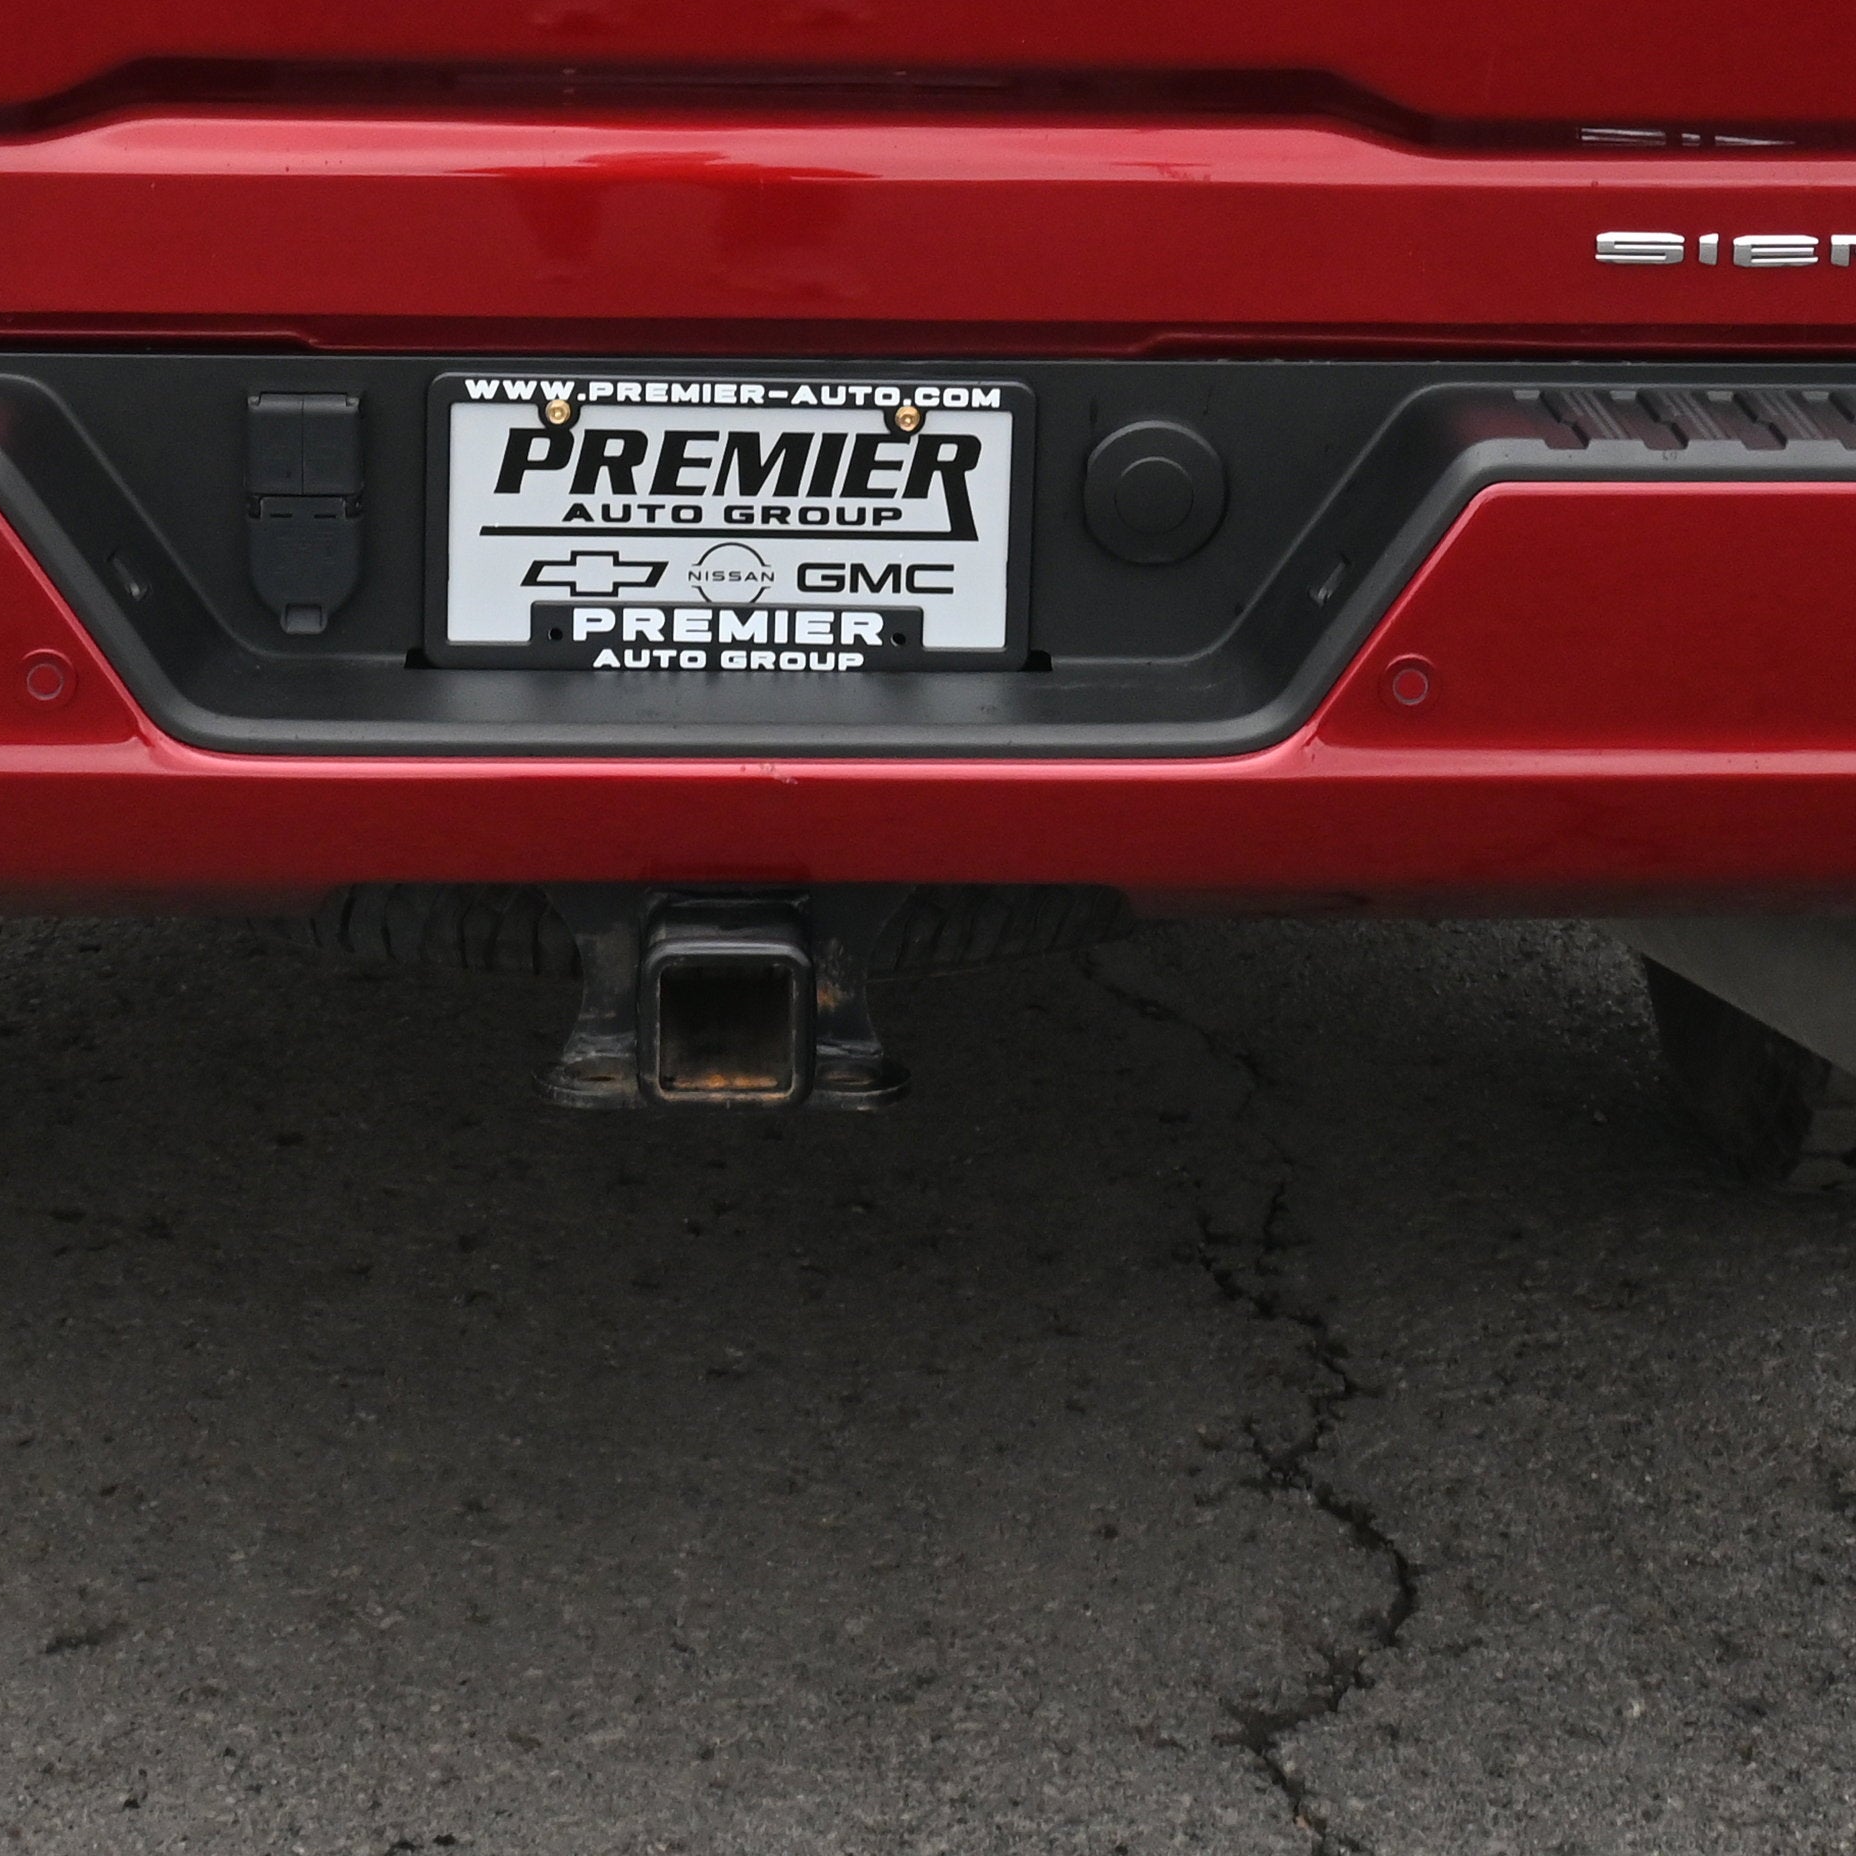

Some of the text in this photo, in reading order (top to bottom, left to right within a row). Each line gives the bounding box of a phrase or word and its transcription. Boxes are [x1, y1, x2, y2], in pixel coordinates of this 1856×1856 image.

[464, 379, 1001, 408] WWW.PREMIER-AUTO.COM
[494, 427, 981, 532] PREMIER
[562, 503, 903, 526] AUTO GROUP
[688, 570, 774, 582] NISSAN
[797, 562, 955, 594] GMC
[573, 608, 884, 646] PREMIER
[593, 648, 865, 671] AUTO GROUP
